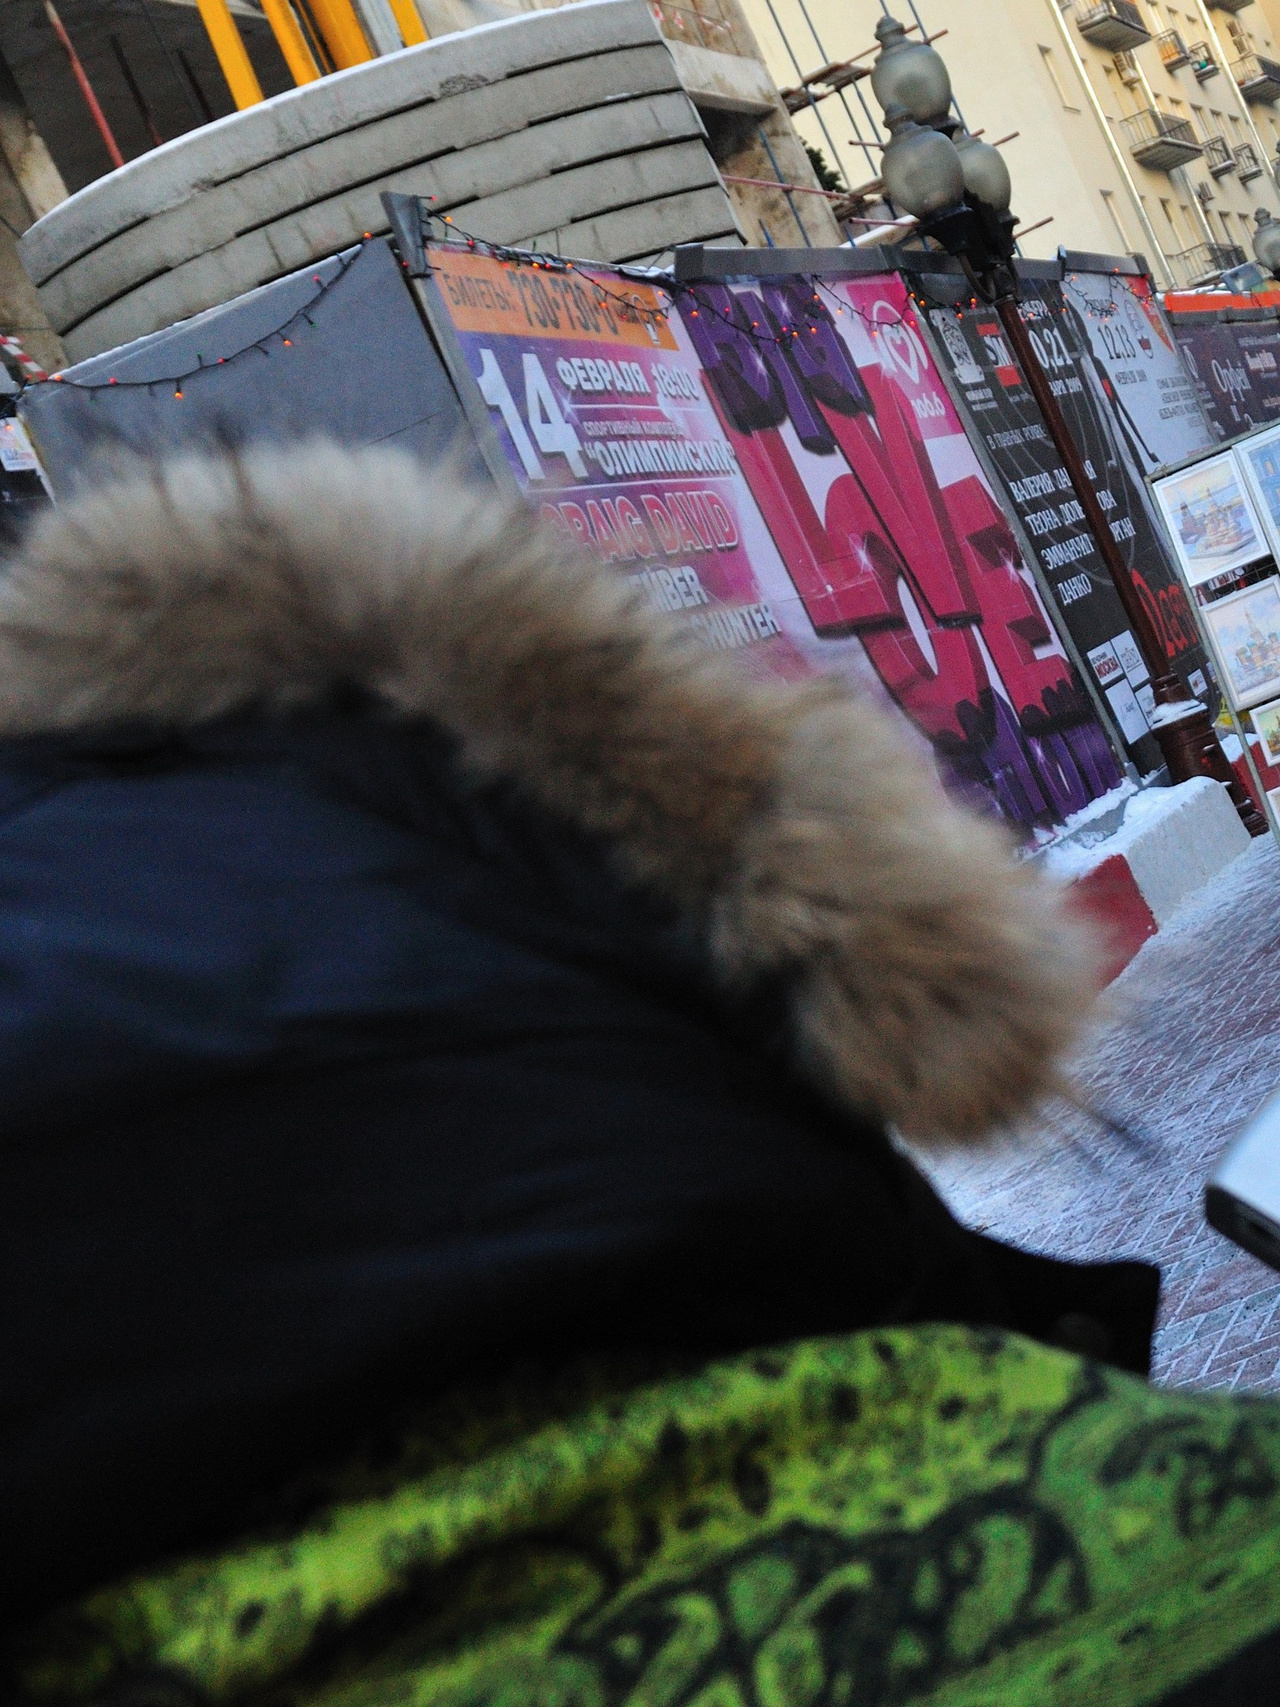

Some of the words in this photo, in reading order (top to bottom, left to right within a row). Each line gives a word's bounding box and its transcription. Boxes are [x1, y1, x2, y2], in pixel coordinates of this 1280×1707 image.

[1097, 324, 1137, 364] 12,13
[556, 357, 651, 395] ФЕВРАЛЯ
[651, 363, 701, 401] 18:00
[477, 348, 589, 482] 14
[986, 435, 996, 450] В
[993, 428, 1025, 447] ГЛАВНЫХ
[1009, 472, 1056, 502] ВАЛЕРИЯ
[640, 490, 738, 554] DAVID
[1025, 509, 1062, 536] ТЕОНА
[699, 362, 1075, 742] LOVE
[1041, 533, 1095, 570] ЭММАНУИЛ
[1057, 573, 1092, 606] ДАНКО
